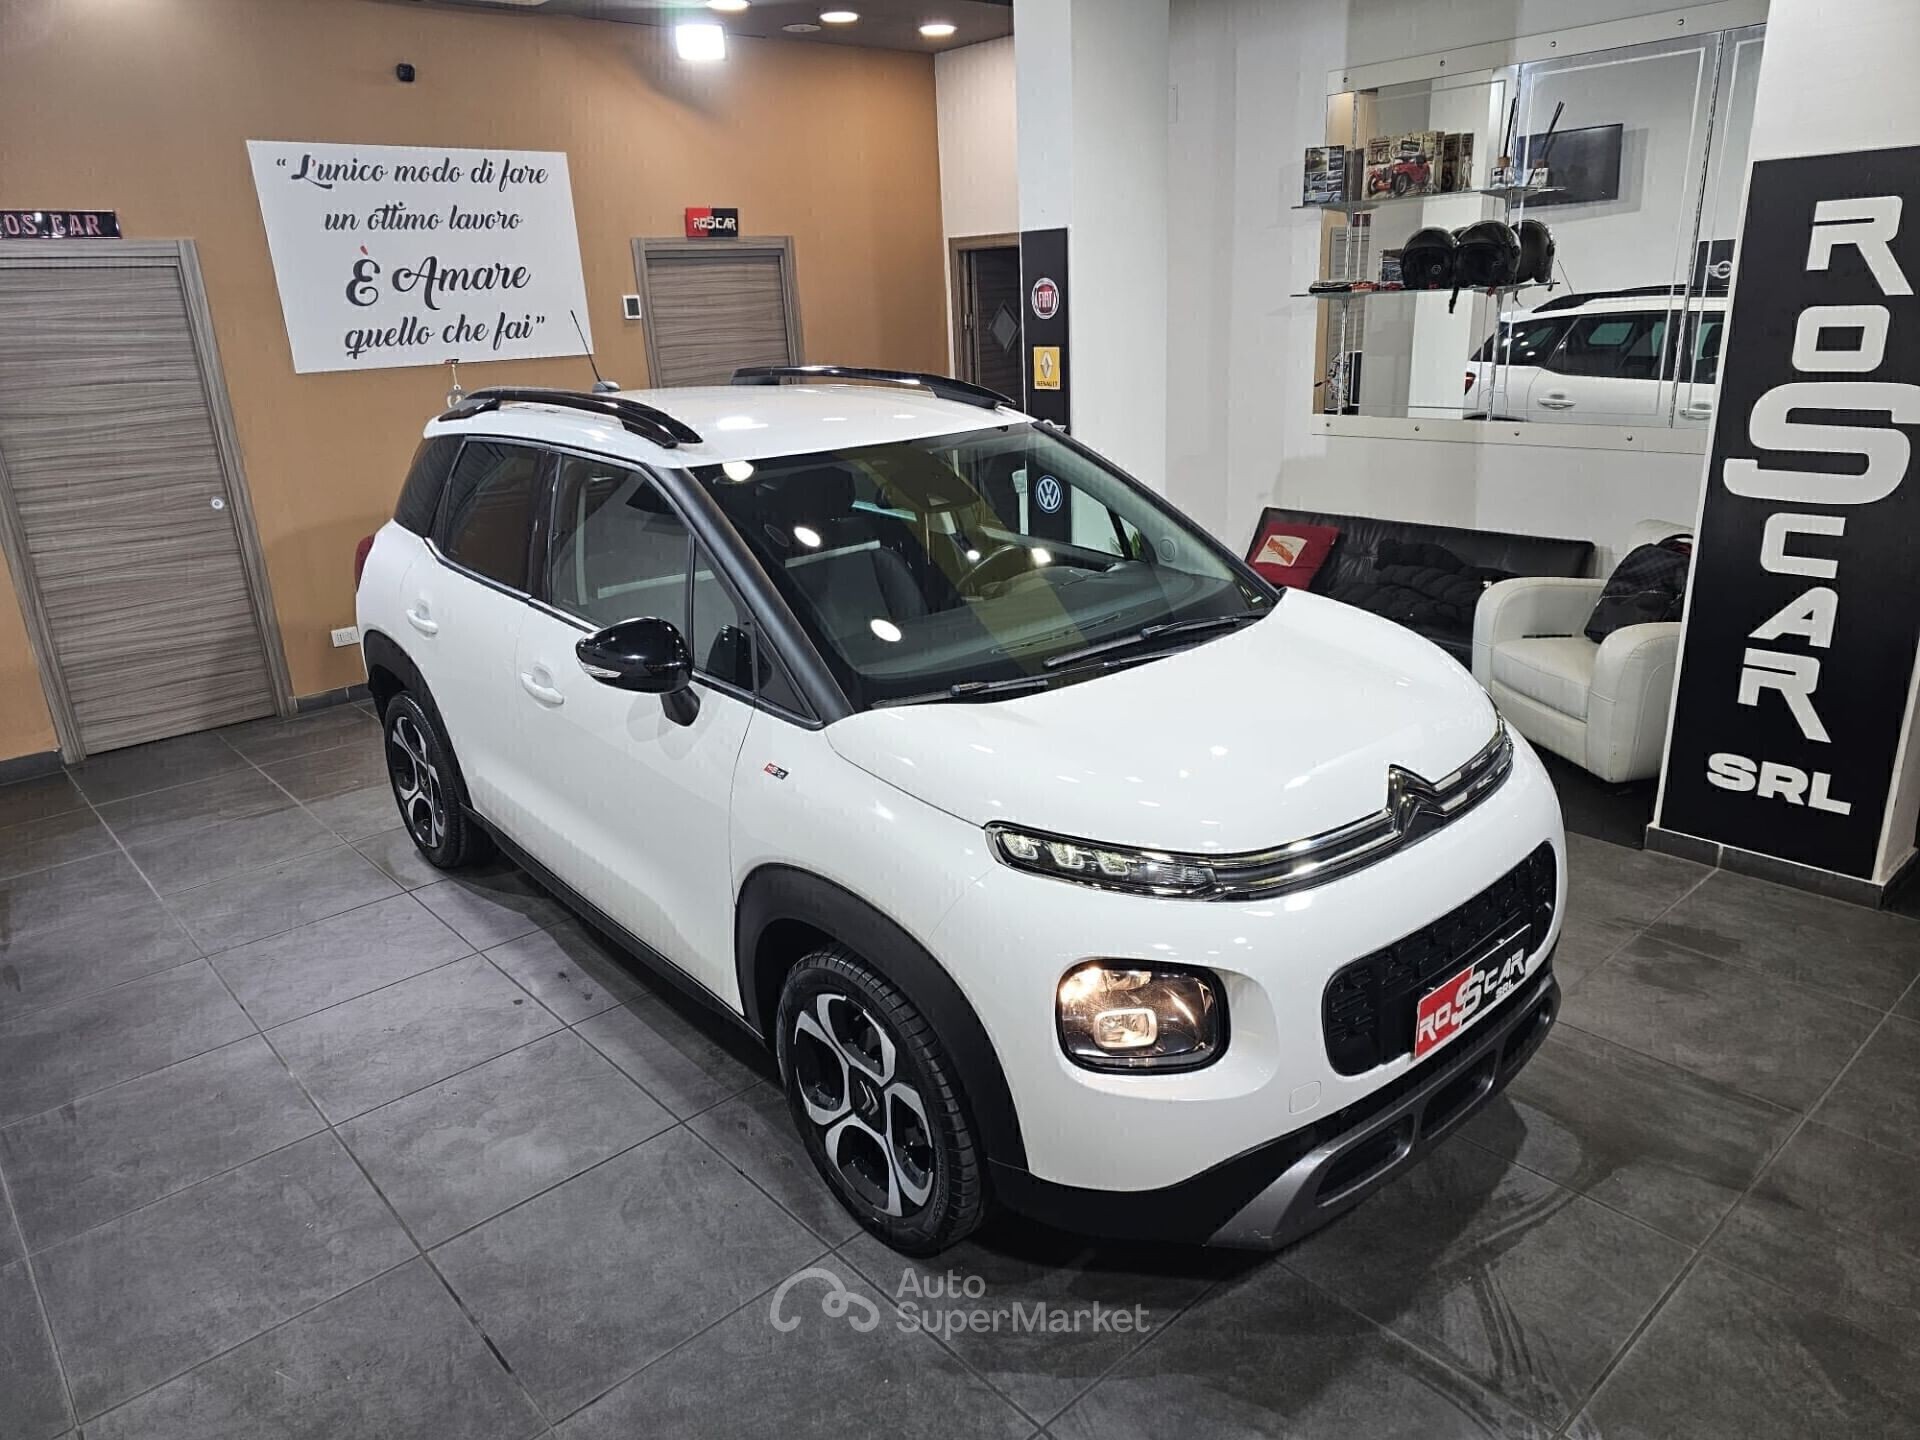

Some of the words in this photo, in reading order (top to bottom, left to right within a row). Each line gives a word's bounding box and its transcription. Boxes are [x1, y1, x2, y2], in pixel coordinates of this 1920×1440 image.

[394, 157, 464, 183] modo
[470, 158, 496, 183] di
[498, 158, 549, 193] fare
[50, 213, 102, 236] CAR
[324, 212, 360, 231] un
[367, 201, 443, 231] ottimo
[449, 204, 523, 231] lavoro
[692, 215, 736, 231] ROSCAR
[345, 245, 381, 307] È
[391, 255, 531, 310] Amare
[1038, 291, 1053, 308] FIAT
[344, 316, 435, 360] quello
[441, 314, 489, 344] che
[1706, 752, 1852, 816] SRL
[1417, 947, 1525, 1042] ROSCAR
